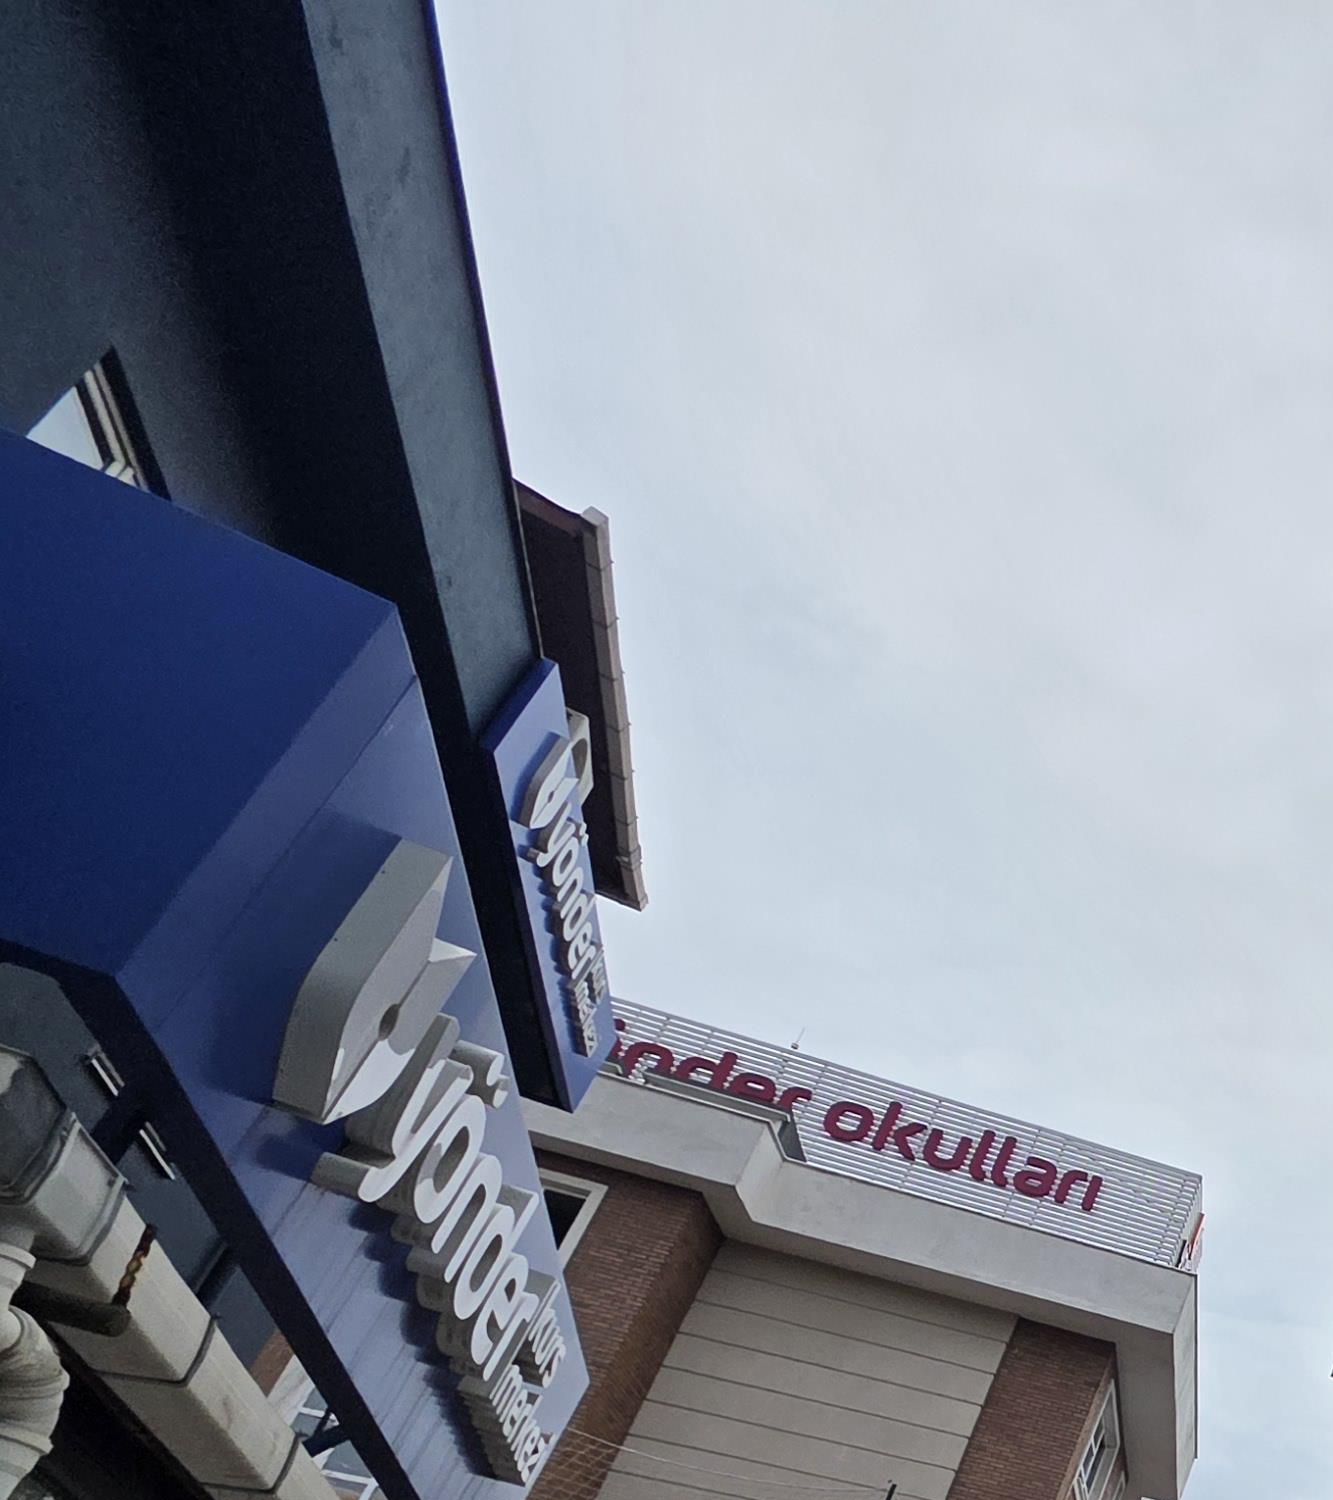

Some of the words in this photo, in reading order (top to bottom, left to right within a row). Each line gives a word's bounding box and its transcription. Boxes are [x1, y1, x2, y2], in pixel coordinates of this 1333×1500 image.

[823, 1100, 1104, 1212] okulları
[358, 1052, 540, 1381] yönder
[528, 1280, 567, 1389] kurs
